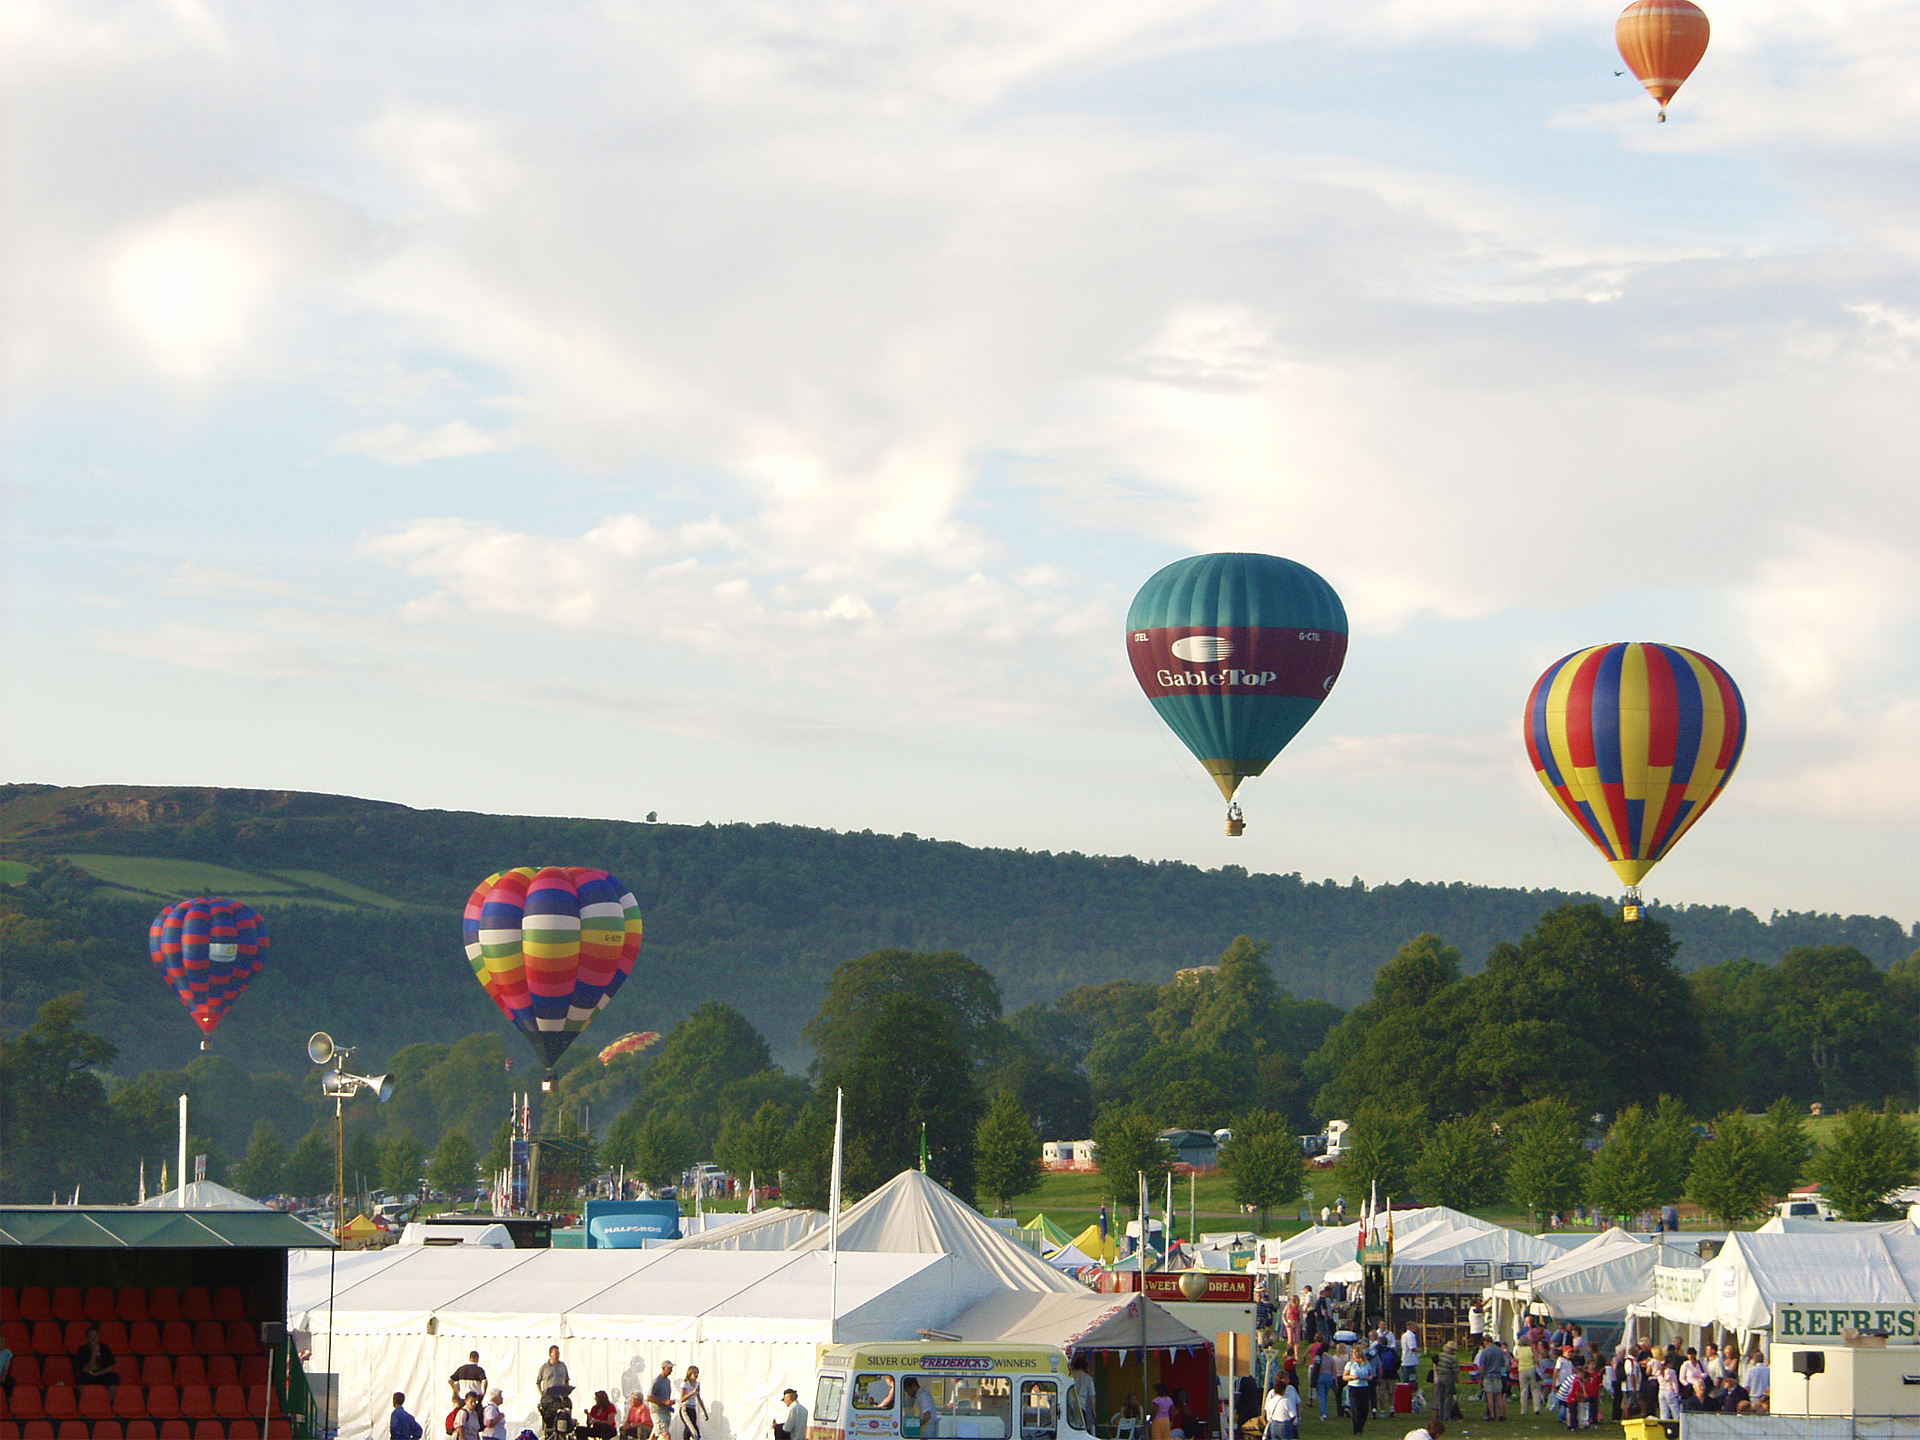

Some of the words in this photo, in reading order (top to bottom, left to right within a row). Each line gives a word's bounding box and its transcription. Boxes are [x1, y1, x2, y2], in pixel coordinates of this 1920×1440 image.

[604, 1226, 662, 1234] HALFORDS
[1208, 1281, 1246, 1292] DREAM
[1781, 1309, 1920, 1337] REFRES
[867, 1356, 898, 1366] SILVER
[901, 1357, 919, 1366] CUP
[994, 1359, 1037, 1368] WINNERS
